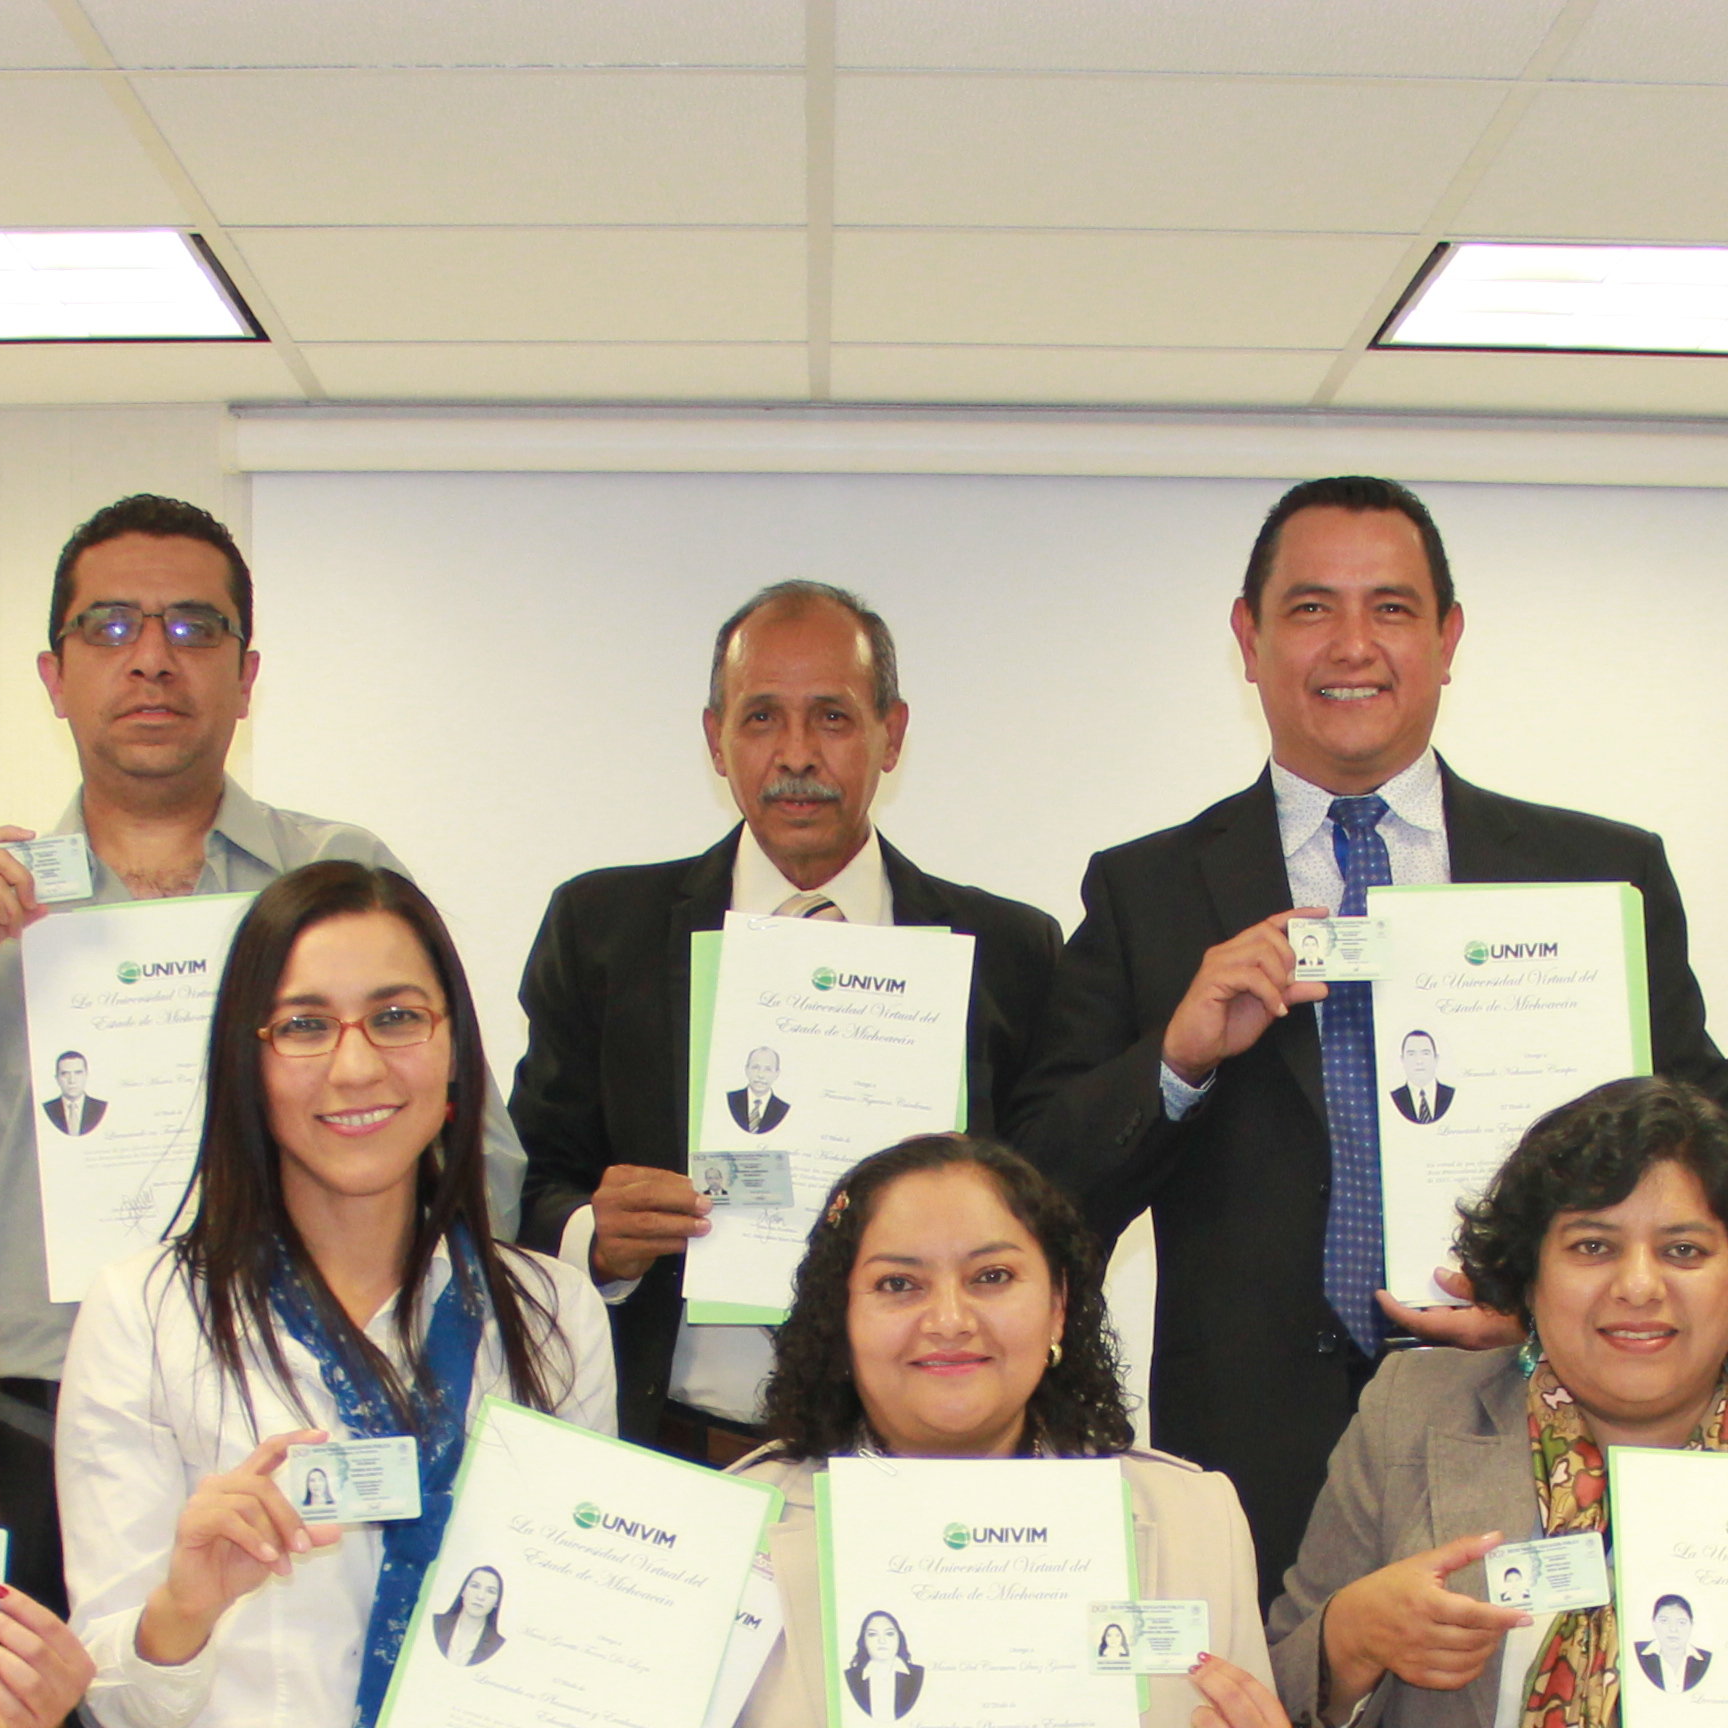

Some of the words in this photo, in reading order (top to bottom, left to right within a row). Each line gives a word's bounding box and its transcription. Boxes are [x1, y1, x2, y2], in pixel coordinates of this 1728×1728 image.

[1490, 942, 1559, 959] UNIVIM
[142, 958, 207, 978] UNIVIM
[1443, 972, 1525, 990] Universidad
[1527, 966, 1577, 986] Virtual
[1578, 969, 1599, 983] del
[838, 973, 907, 994] UNIVIM
[786, 994, 869, 1016] Universidad
[870, 1002, 920, 1022] Virtual
[919, 1011, 941, 1024] del
[1435, 998, 1483, 1016] Estado
[1485, 999, 1500, 1013] de
[1503, 994, 1578, 1013] Michoacán
[775, 1016, 821, 1035] Estado
[824, 1025, 839, 1036] de
[841, 1023, 916, 1045] Michoacán
[601, 1512, 677, 1549] UNIVIM
[972, 1526, 1048, 1543] UNIVIM
[540, 1524, 630, 1564] Universidad
[630, 1554, 686, 1583] Virtual
[684, 1573, 709, 1588] del
[918, 1555, 1011, 1574] Universidad
[1013, 1554, 1069, 1573] Virtual
[1069, 1558, 1092, 1572] del
[523, 1547, 573, 1576] Estado
[575, 1567, 593, 1582] de
[594, 1569, 675, 1607] Michoacán
[910, 1583, 962, 1601] Estado
[967, 1586, 983, 1600] de
[987, 1582, 1069, 1600] Michoacán
[735, 1611, 763, 1630] VIM
